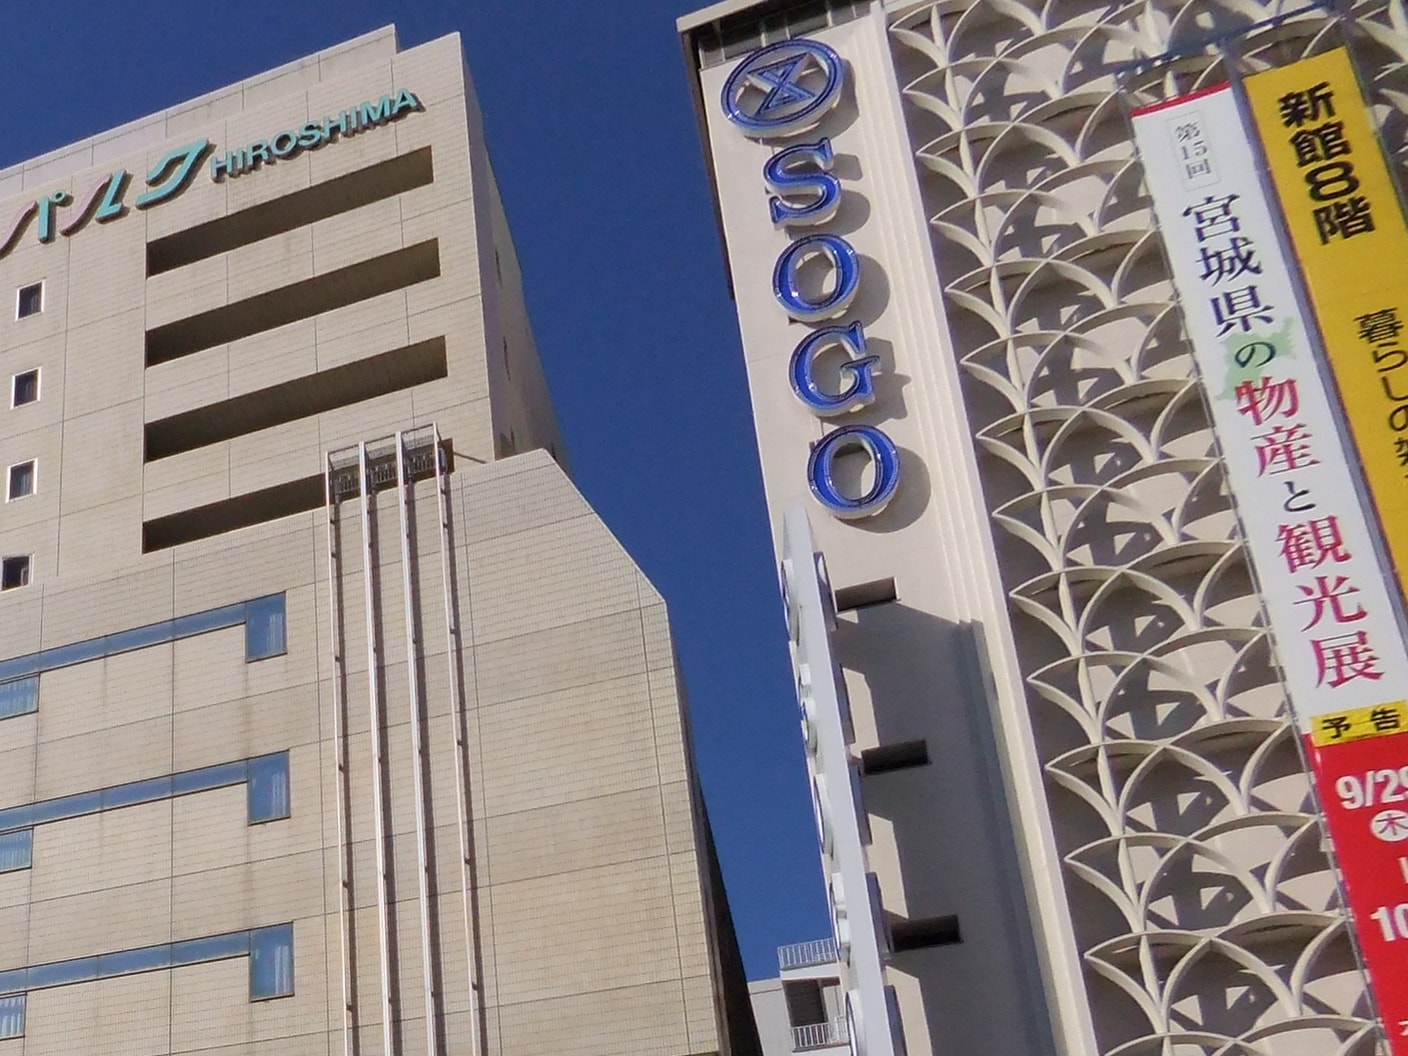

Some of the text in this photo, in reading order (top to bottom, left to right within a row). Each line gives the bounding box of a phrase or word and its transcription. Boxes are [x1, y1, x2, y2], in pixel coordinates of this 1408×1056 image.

[209, 88, 423, 182] HIROSHIMA
[1174, 120, 1212, 180] 第15回
[1277, 80, 1377, 246] 新館8階
[762, 137, 901, 519] SOGO
[1182, 193, 1386, 689] 宮城県の物産と観光展
[1321, 707, 1401, 739] 予告
